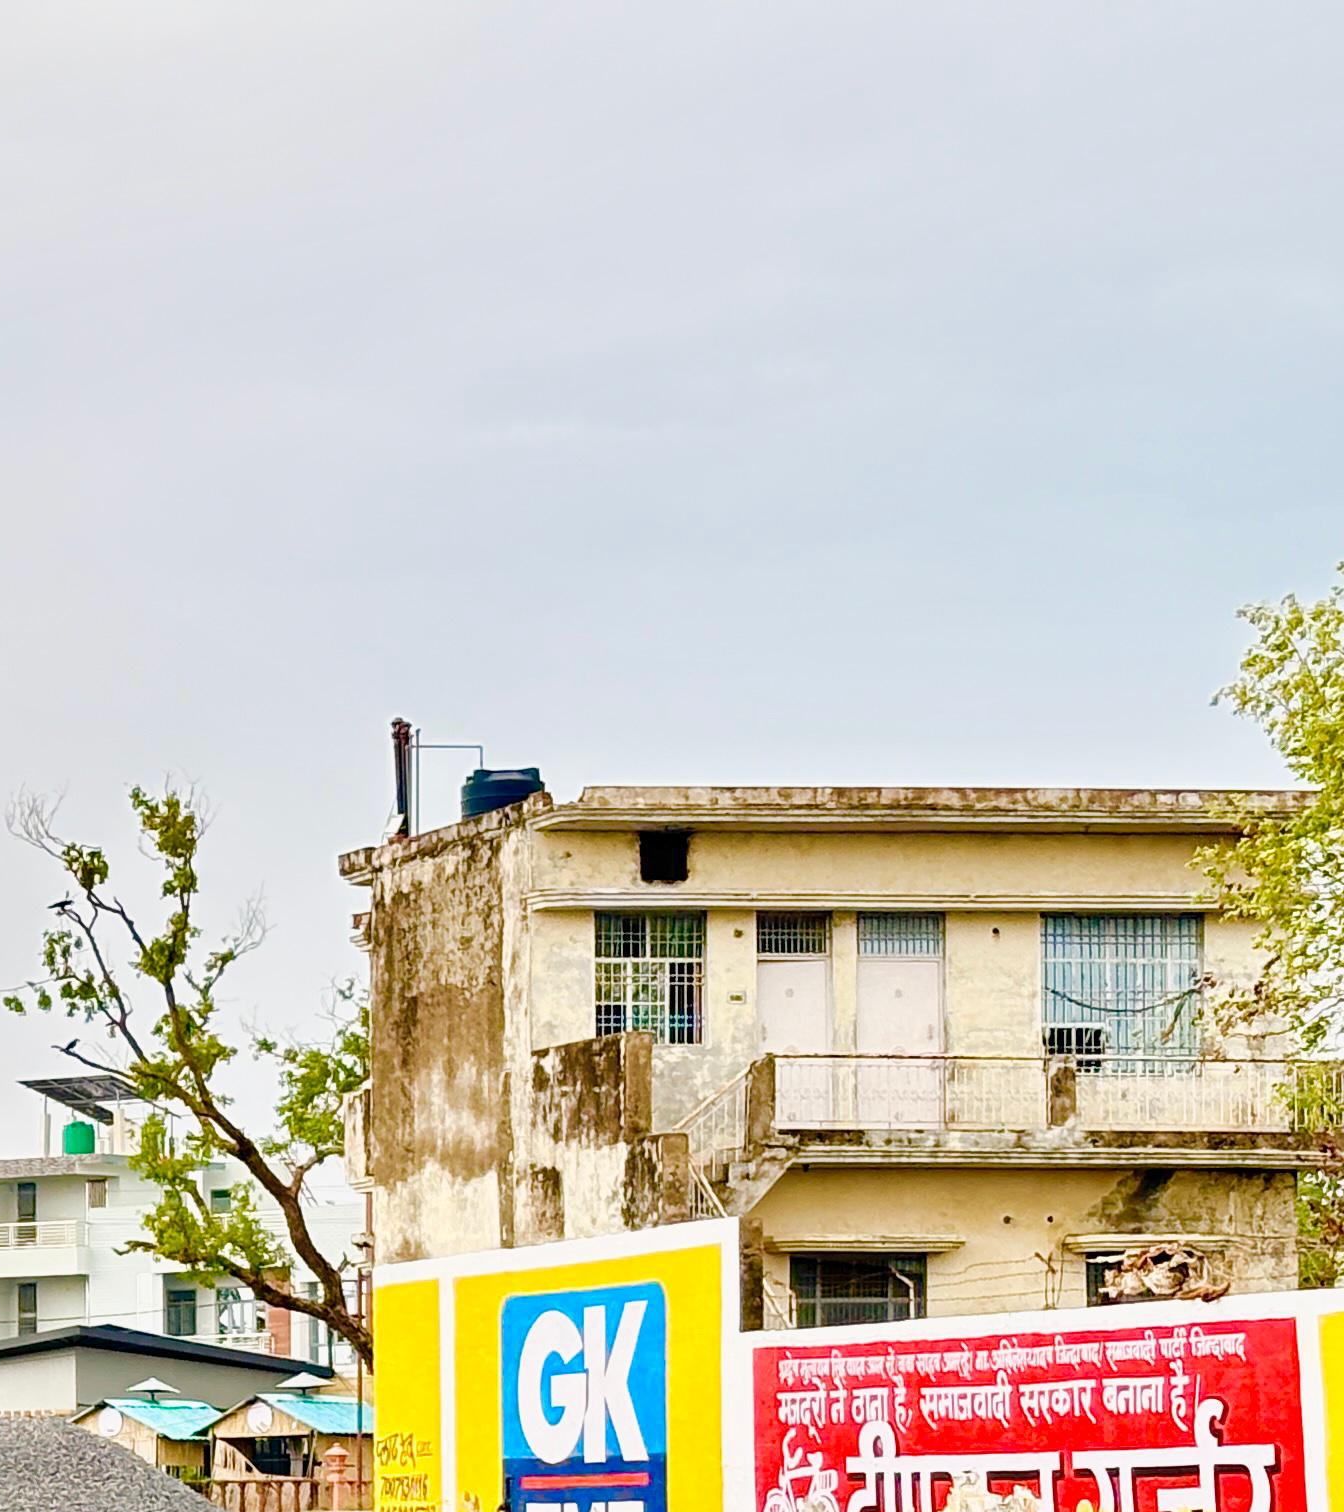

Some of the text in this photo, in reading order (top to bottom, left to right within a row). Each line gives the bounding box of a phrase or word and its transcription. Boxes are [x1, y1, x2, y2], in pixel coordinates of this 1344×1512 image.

[517, 1299, 649, 1464] GK
[829, 1375, 847, 1424] ने
[851, 1386, 889, 1422] ठाना
[919, 1370, 1012, 1433] समाजवादी
[1019, 1379, 1096, 1427] सरकार
[1101, 1377, 1166, 1415] बनाना
